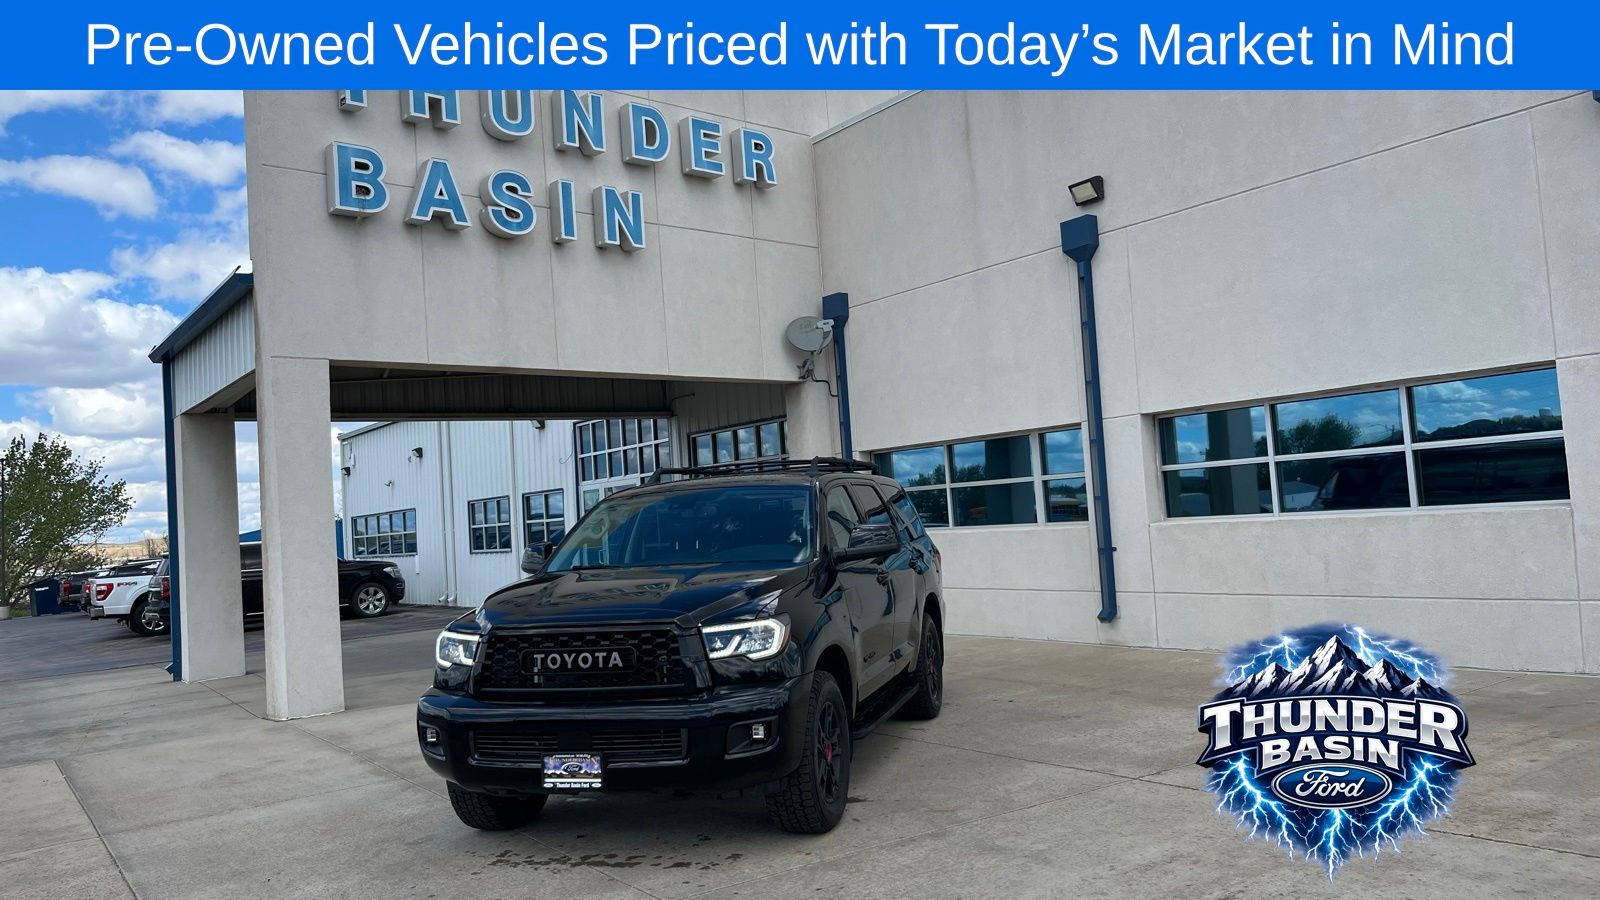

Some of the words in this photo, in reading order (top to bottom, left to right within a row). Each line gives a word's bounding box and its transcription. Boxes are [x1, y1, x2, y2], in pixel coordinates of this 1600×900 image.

[338, 90, 778, 189] UNDER
[325, 141, 646, 250] BASIN
[533, 651, 623, 669] TOYOTA
